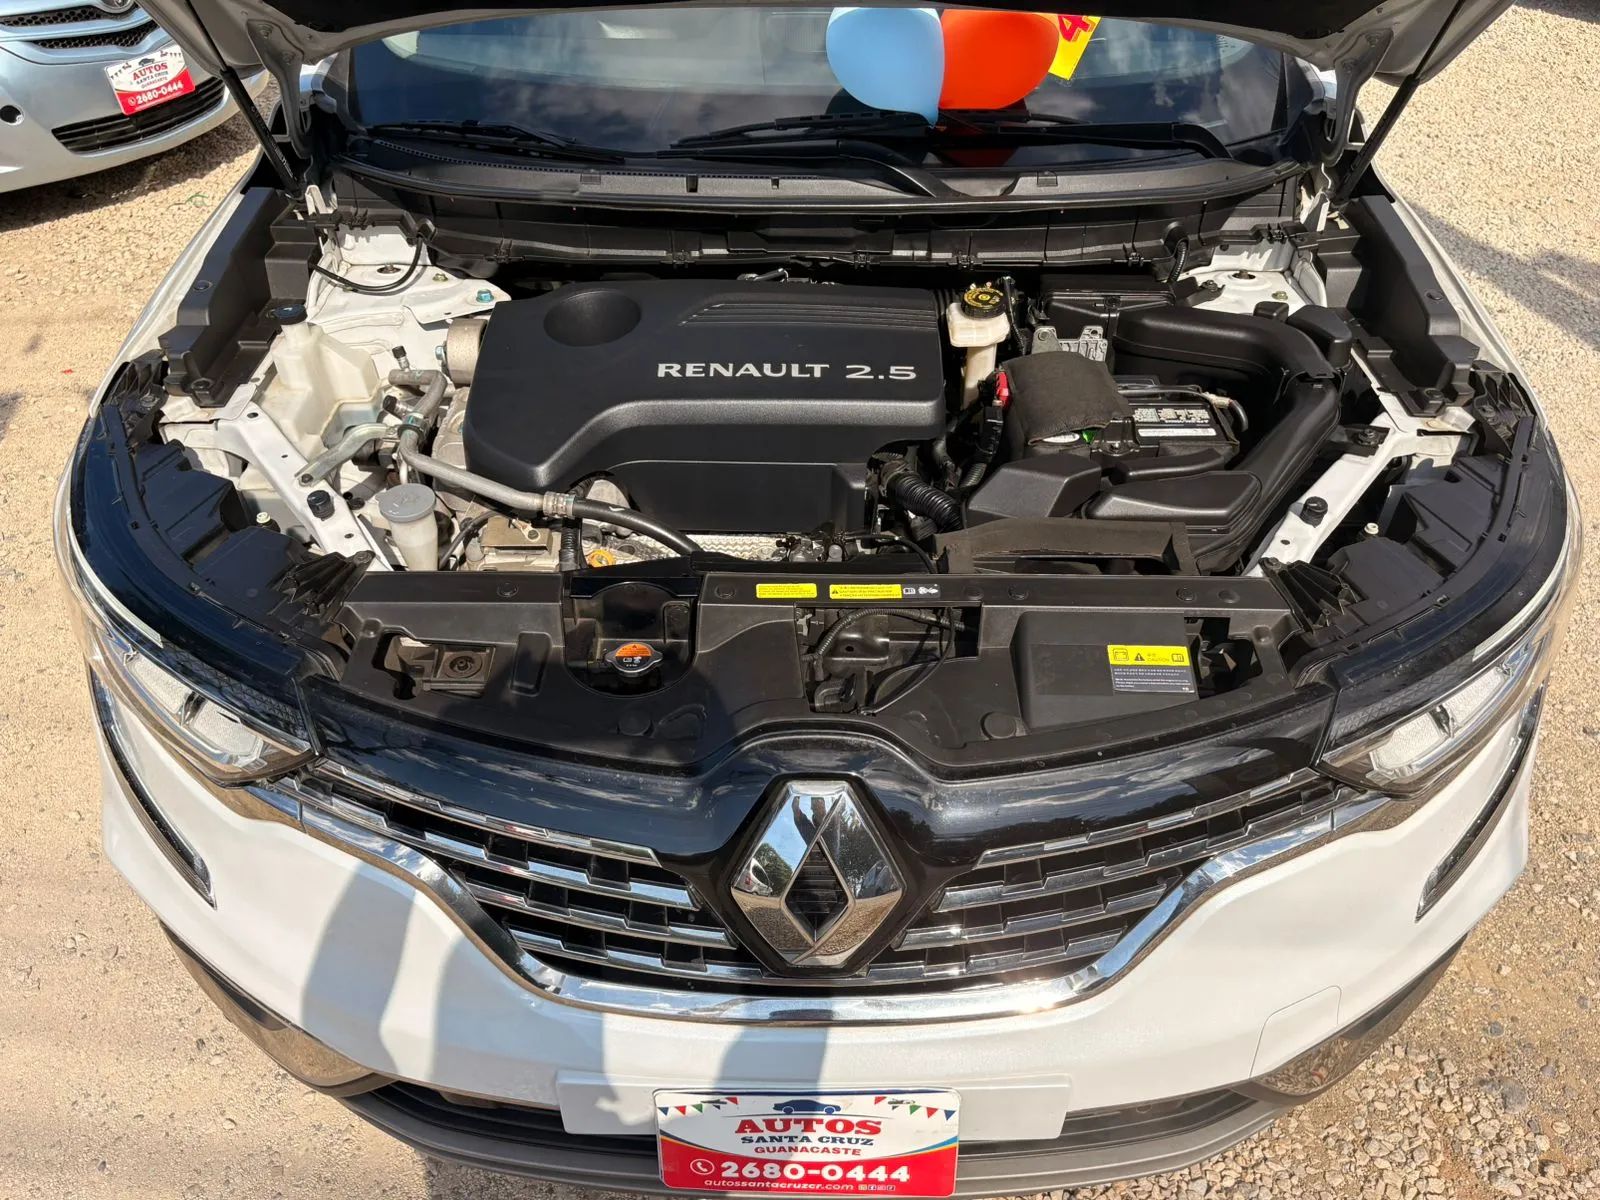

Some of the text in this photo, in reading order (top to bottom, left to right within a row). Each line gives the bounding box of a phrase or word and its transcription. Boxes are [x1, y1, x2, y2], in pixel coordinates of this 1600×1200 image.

[133, 62, 168, 81] AUTOS
[136, 80, 184, 105] 2680-0444
[657, 363, 918, 381] RENAULT 2.5
[734, 1118, 883, 1136] AUTOS
[740, 1135, 874, 1147] SANTA CRUZ
[754, 1146, 862, 1156] GUANACASTE
[720, 1161, 911, 1183] 2680-0444
[704, 1178, 854, 1191] autossantacruzcr.com
